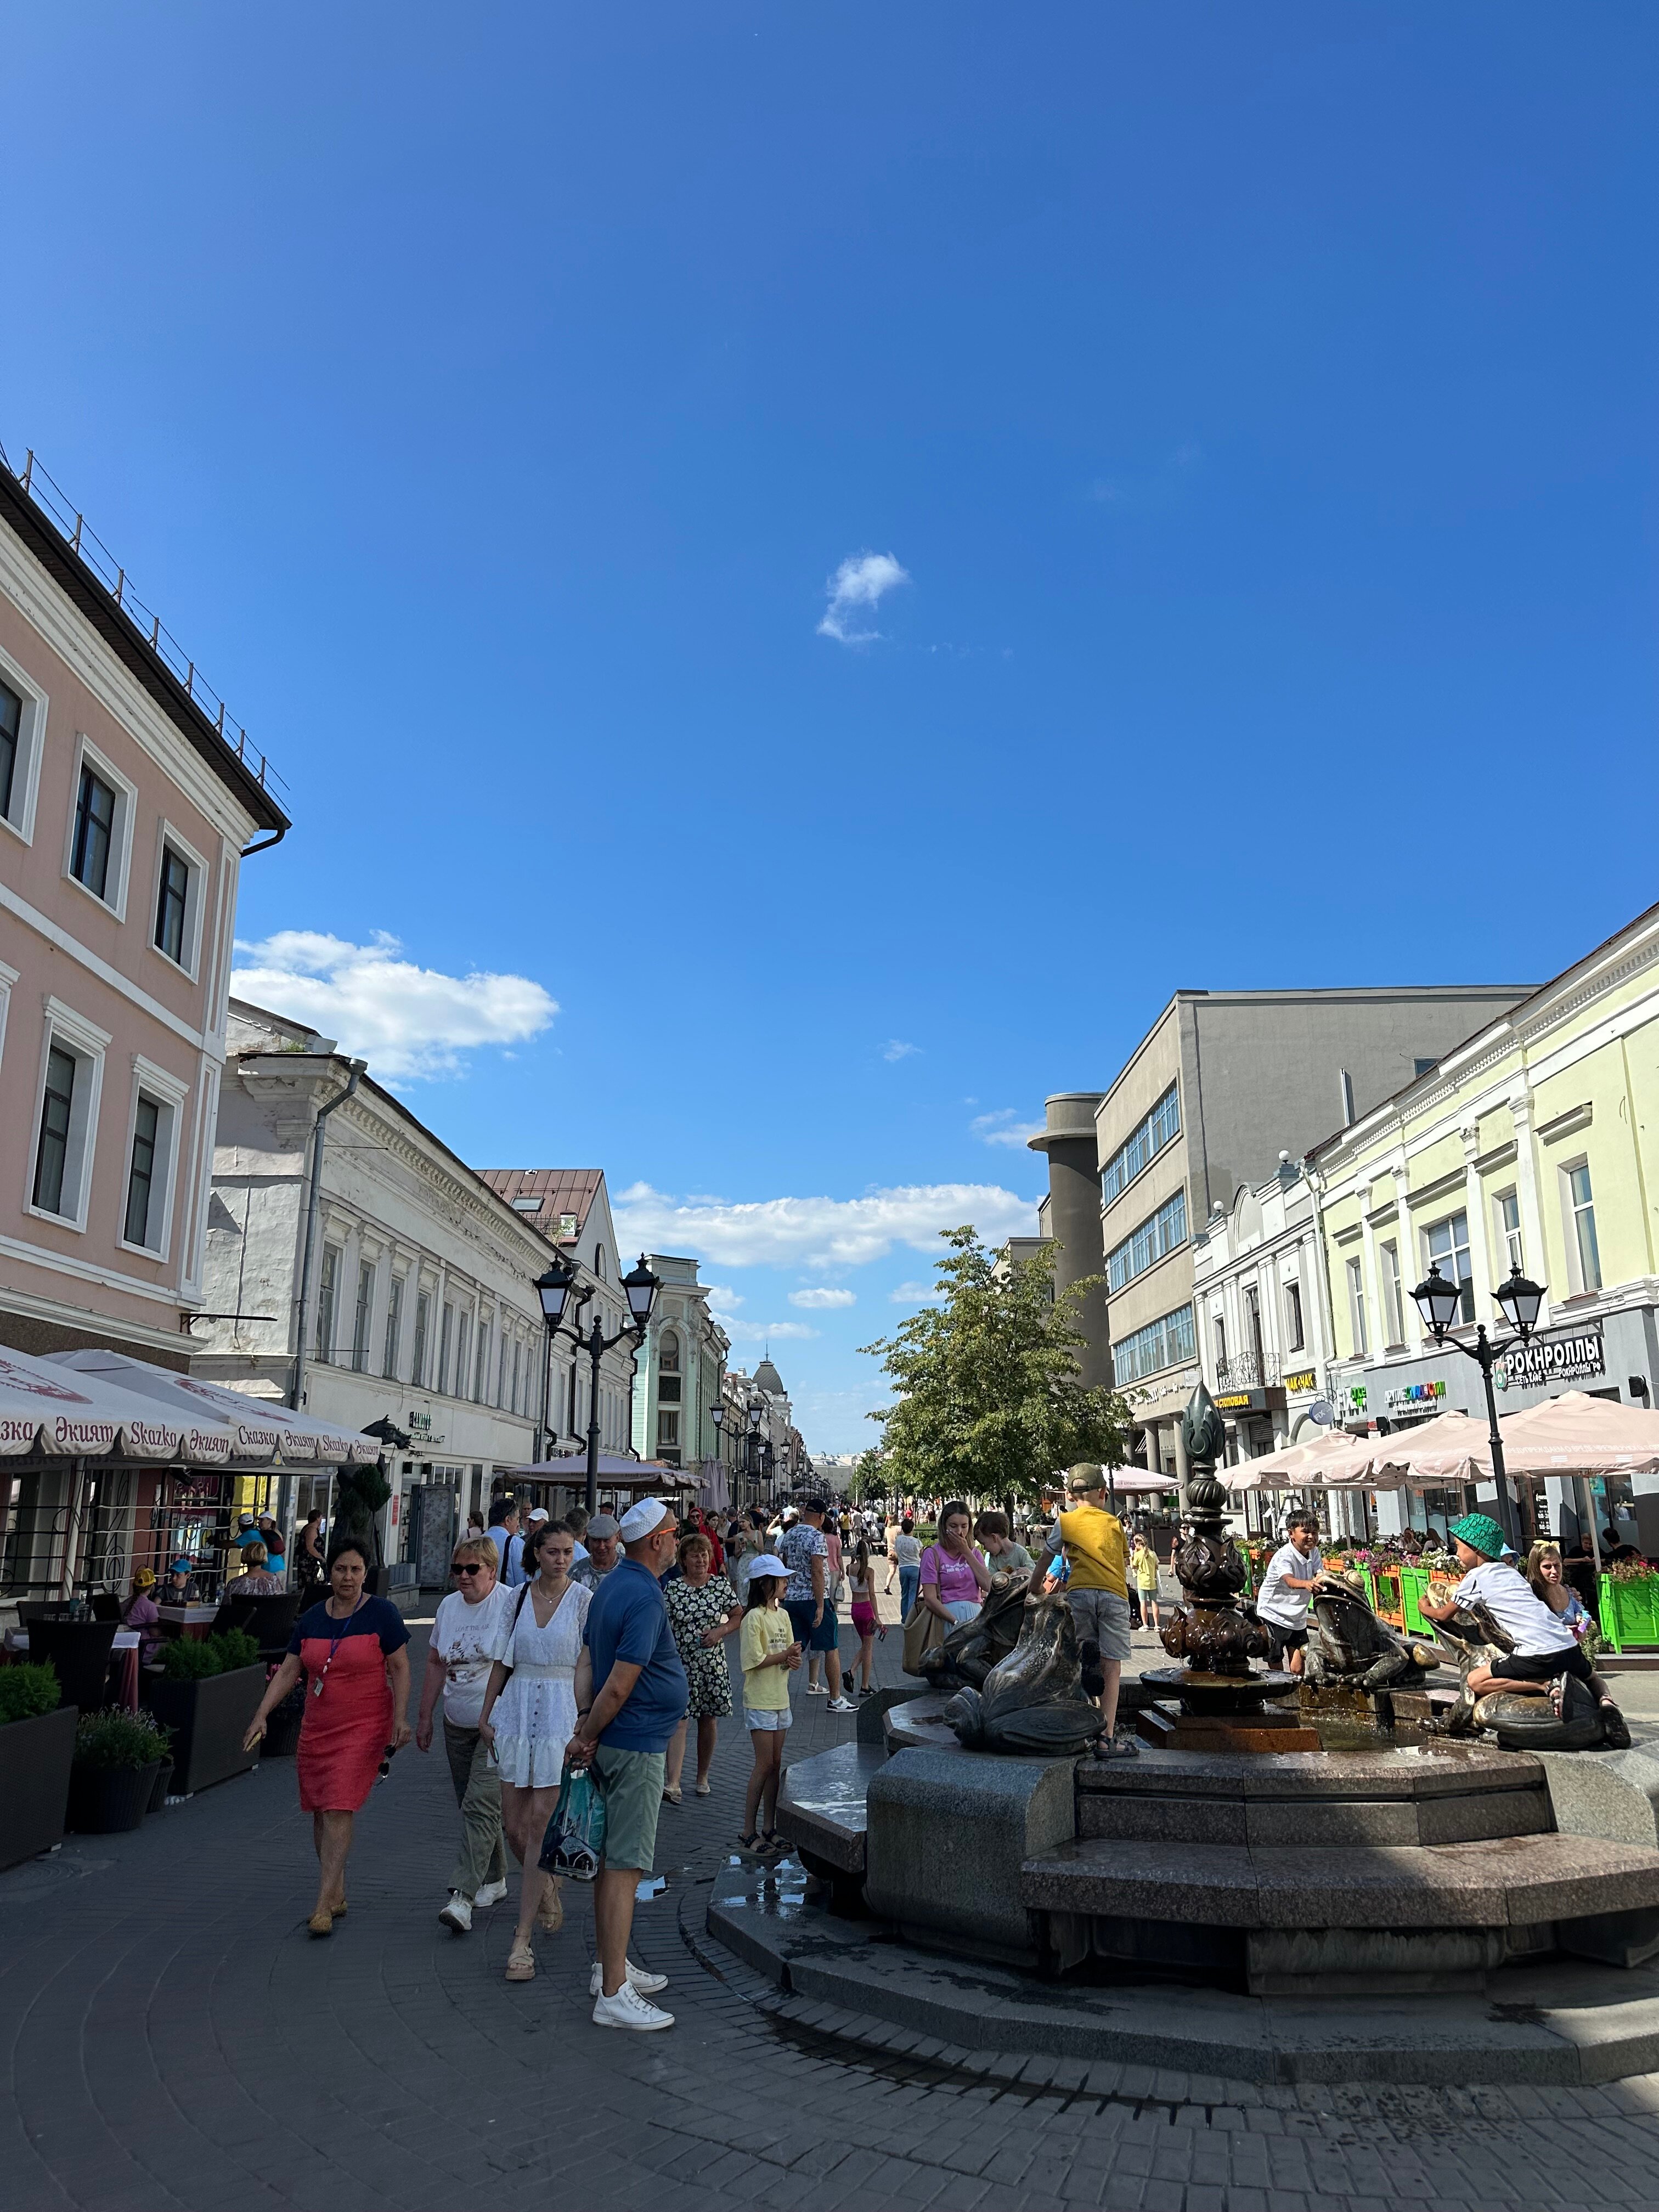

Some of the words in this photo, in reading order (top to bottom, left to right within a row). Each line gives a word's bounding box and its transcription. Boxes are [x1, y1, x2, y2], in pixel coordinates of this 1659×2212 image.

[1506, 1336, 1599, 1375] РОКНРОЛЛЫ
[1516, 1374, 1529, 1385] СЕТЬ
[1529, 1372, 1542, 1383] КАФЕ
[1559, 1362, 1591, 1378] РОКНРОЛЛЫ
[1219, 1395, 1249, 1408] СТОЛОВАЯ
[1313, 1410, 1326, 1421] FIX
[0, 1420, 33, 1441] зка
[130, 1421, 176, 1447] Skazka
[239, 1425, 275, 1446] Сказка
[323, 1435, 348, 1453] Skazka
